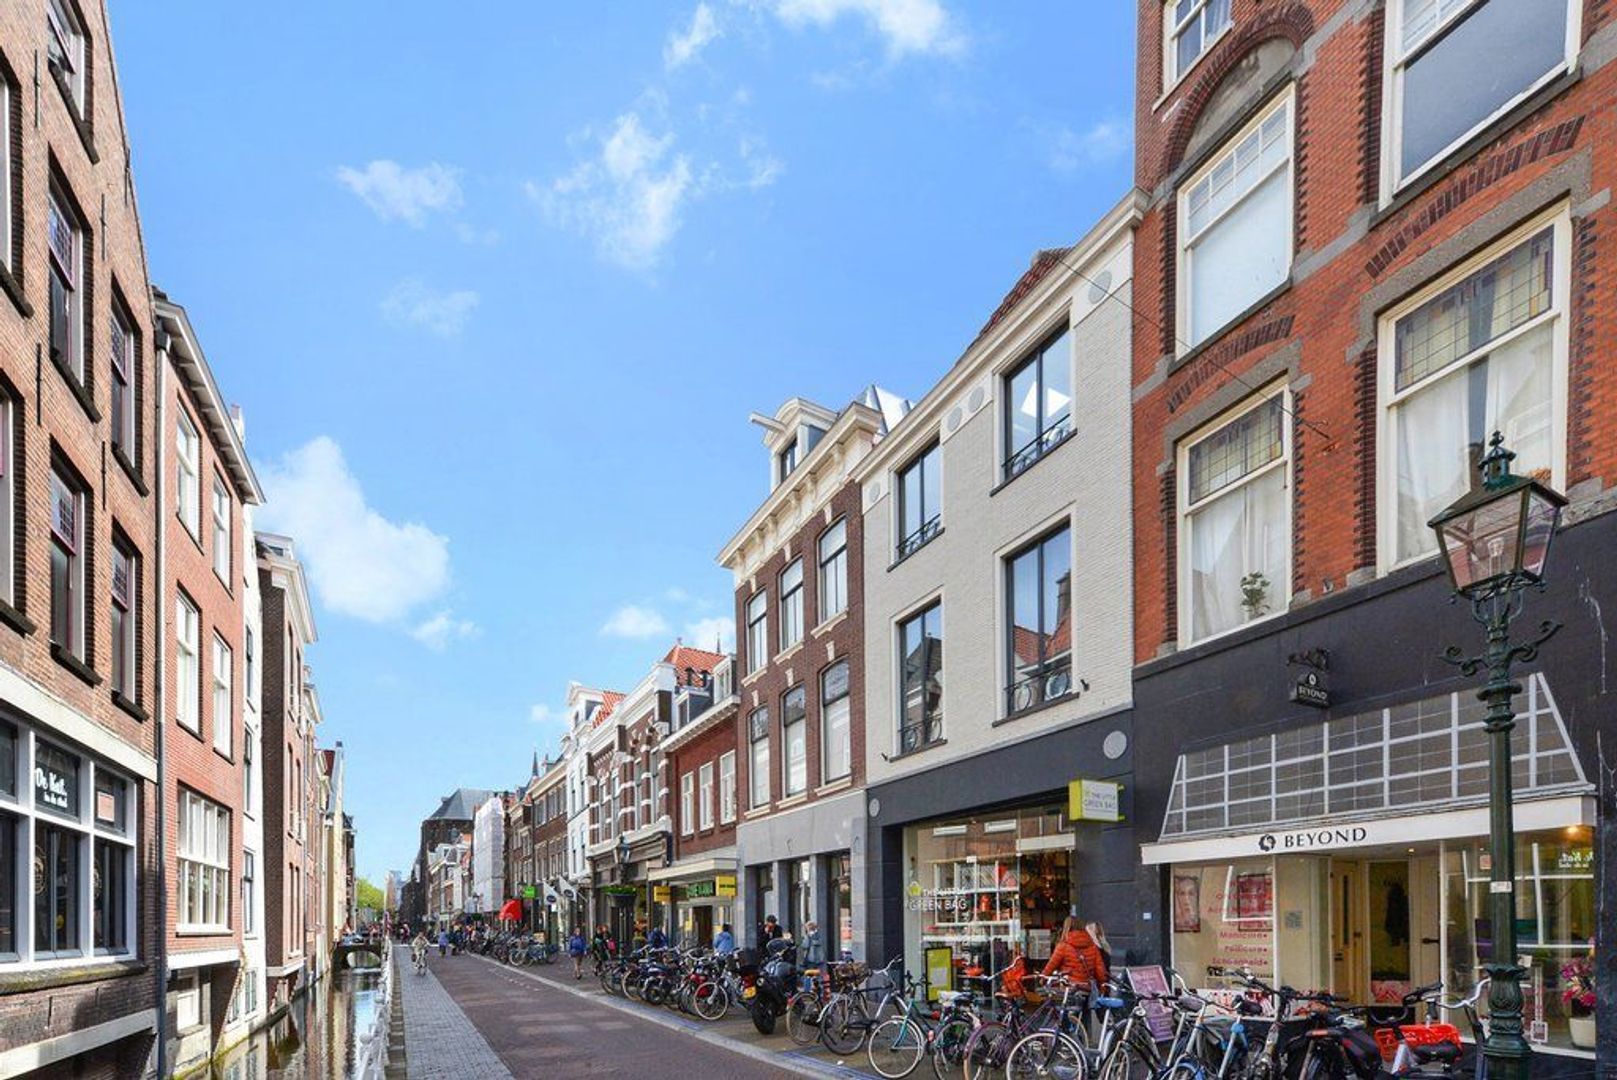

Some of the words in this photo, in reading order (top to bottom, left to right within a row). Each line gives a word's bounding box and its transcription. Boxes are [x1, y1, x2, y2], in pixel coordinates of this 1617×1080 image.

[1285, 827, 1367, 848] BEYOND
[910, 898, 943, 911] GREEN
[944, 898, 968, 911] BAG
